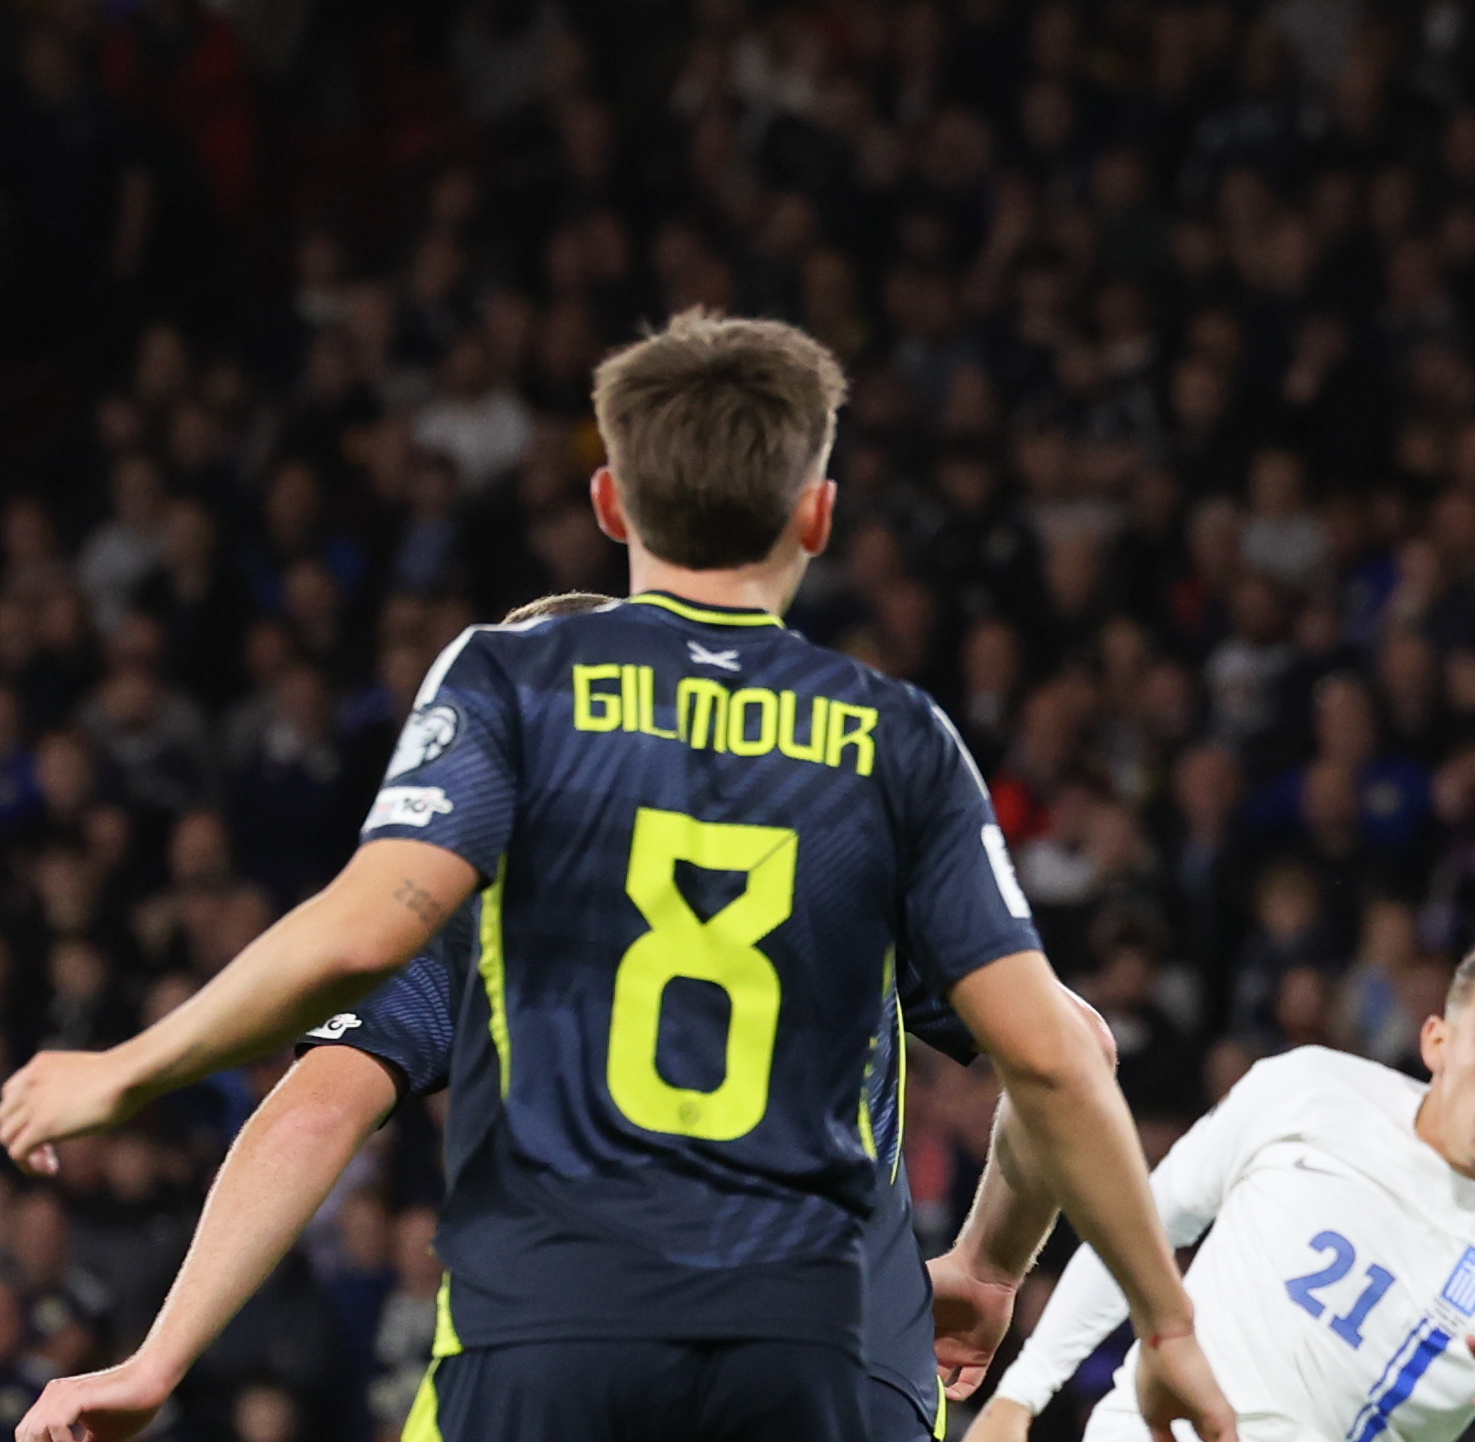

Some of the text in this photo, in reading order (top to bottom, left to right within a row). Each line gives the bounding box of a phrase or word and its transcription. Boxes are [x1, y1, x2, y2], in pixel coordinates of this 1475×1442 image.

[573, 663, 879, 777] GILMOUR
[606, 806, 799, 1142] 8
[1284, 1229, 1397, 1351] 21
